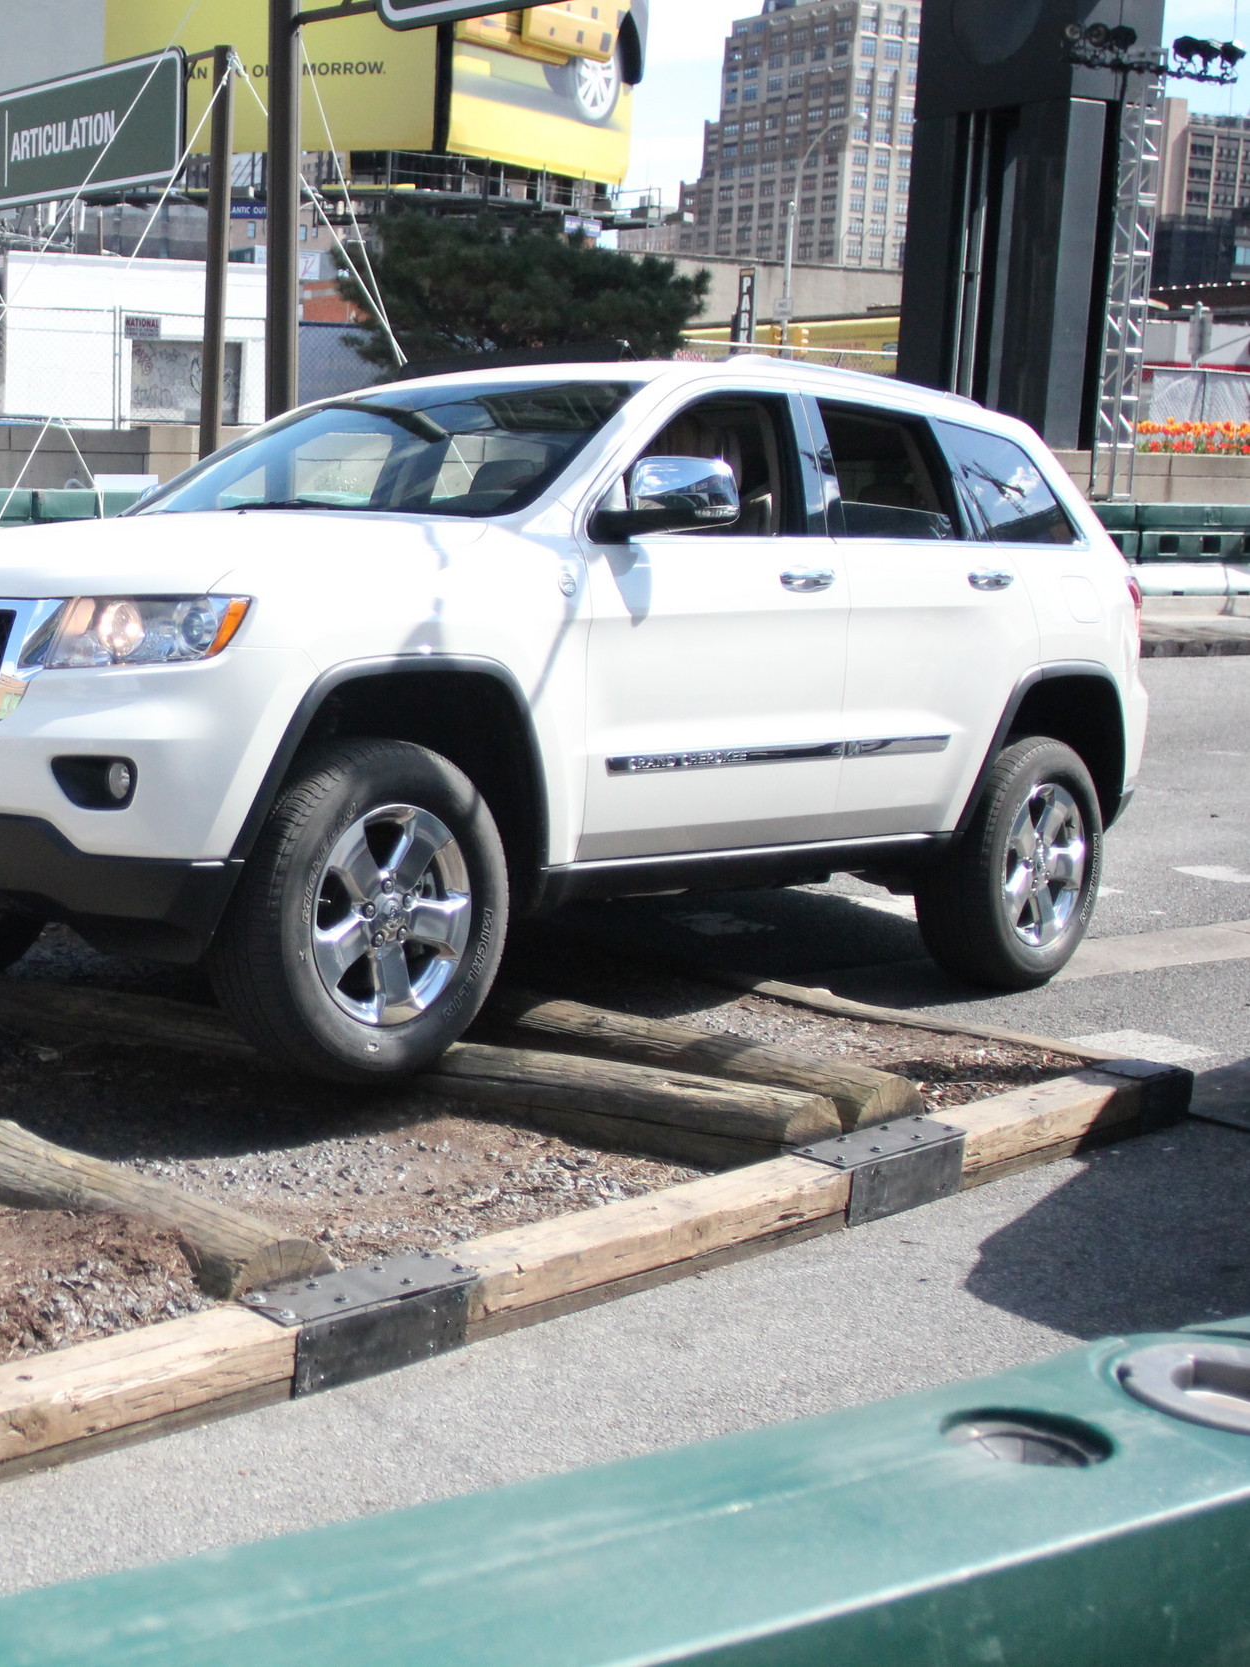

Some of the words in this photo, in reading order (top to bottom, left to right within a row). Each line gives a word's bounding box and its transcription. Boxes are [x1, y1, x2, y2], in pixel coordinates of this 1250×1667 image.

[302, 61, 387, 76] MORROW.
[10, 110, 116, 163] ARTICULATION
[230, 206, 250, 214] ANTIC
[740, 276, 752, 343] PARK
[125, 317, 160, 329] NATIONAL
[629, 756, 675, 770] GRAND
[681, 749, 748, 766] CHEROKEE
[441, 906, 494, 1022] MICHELIN
